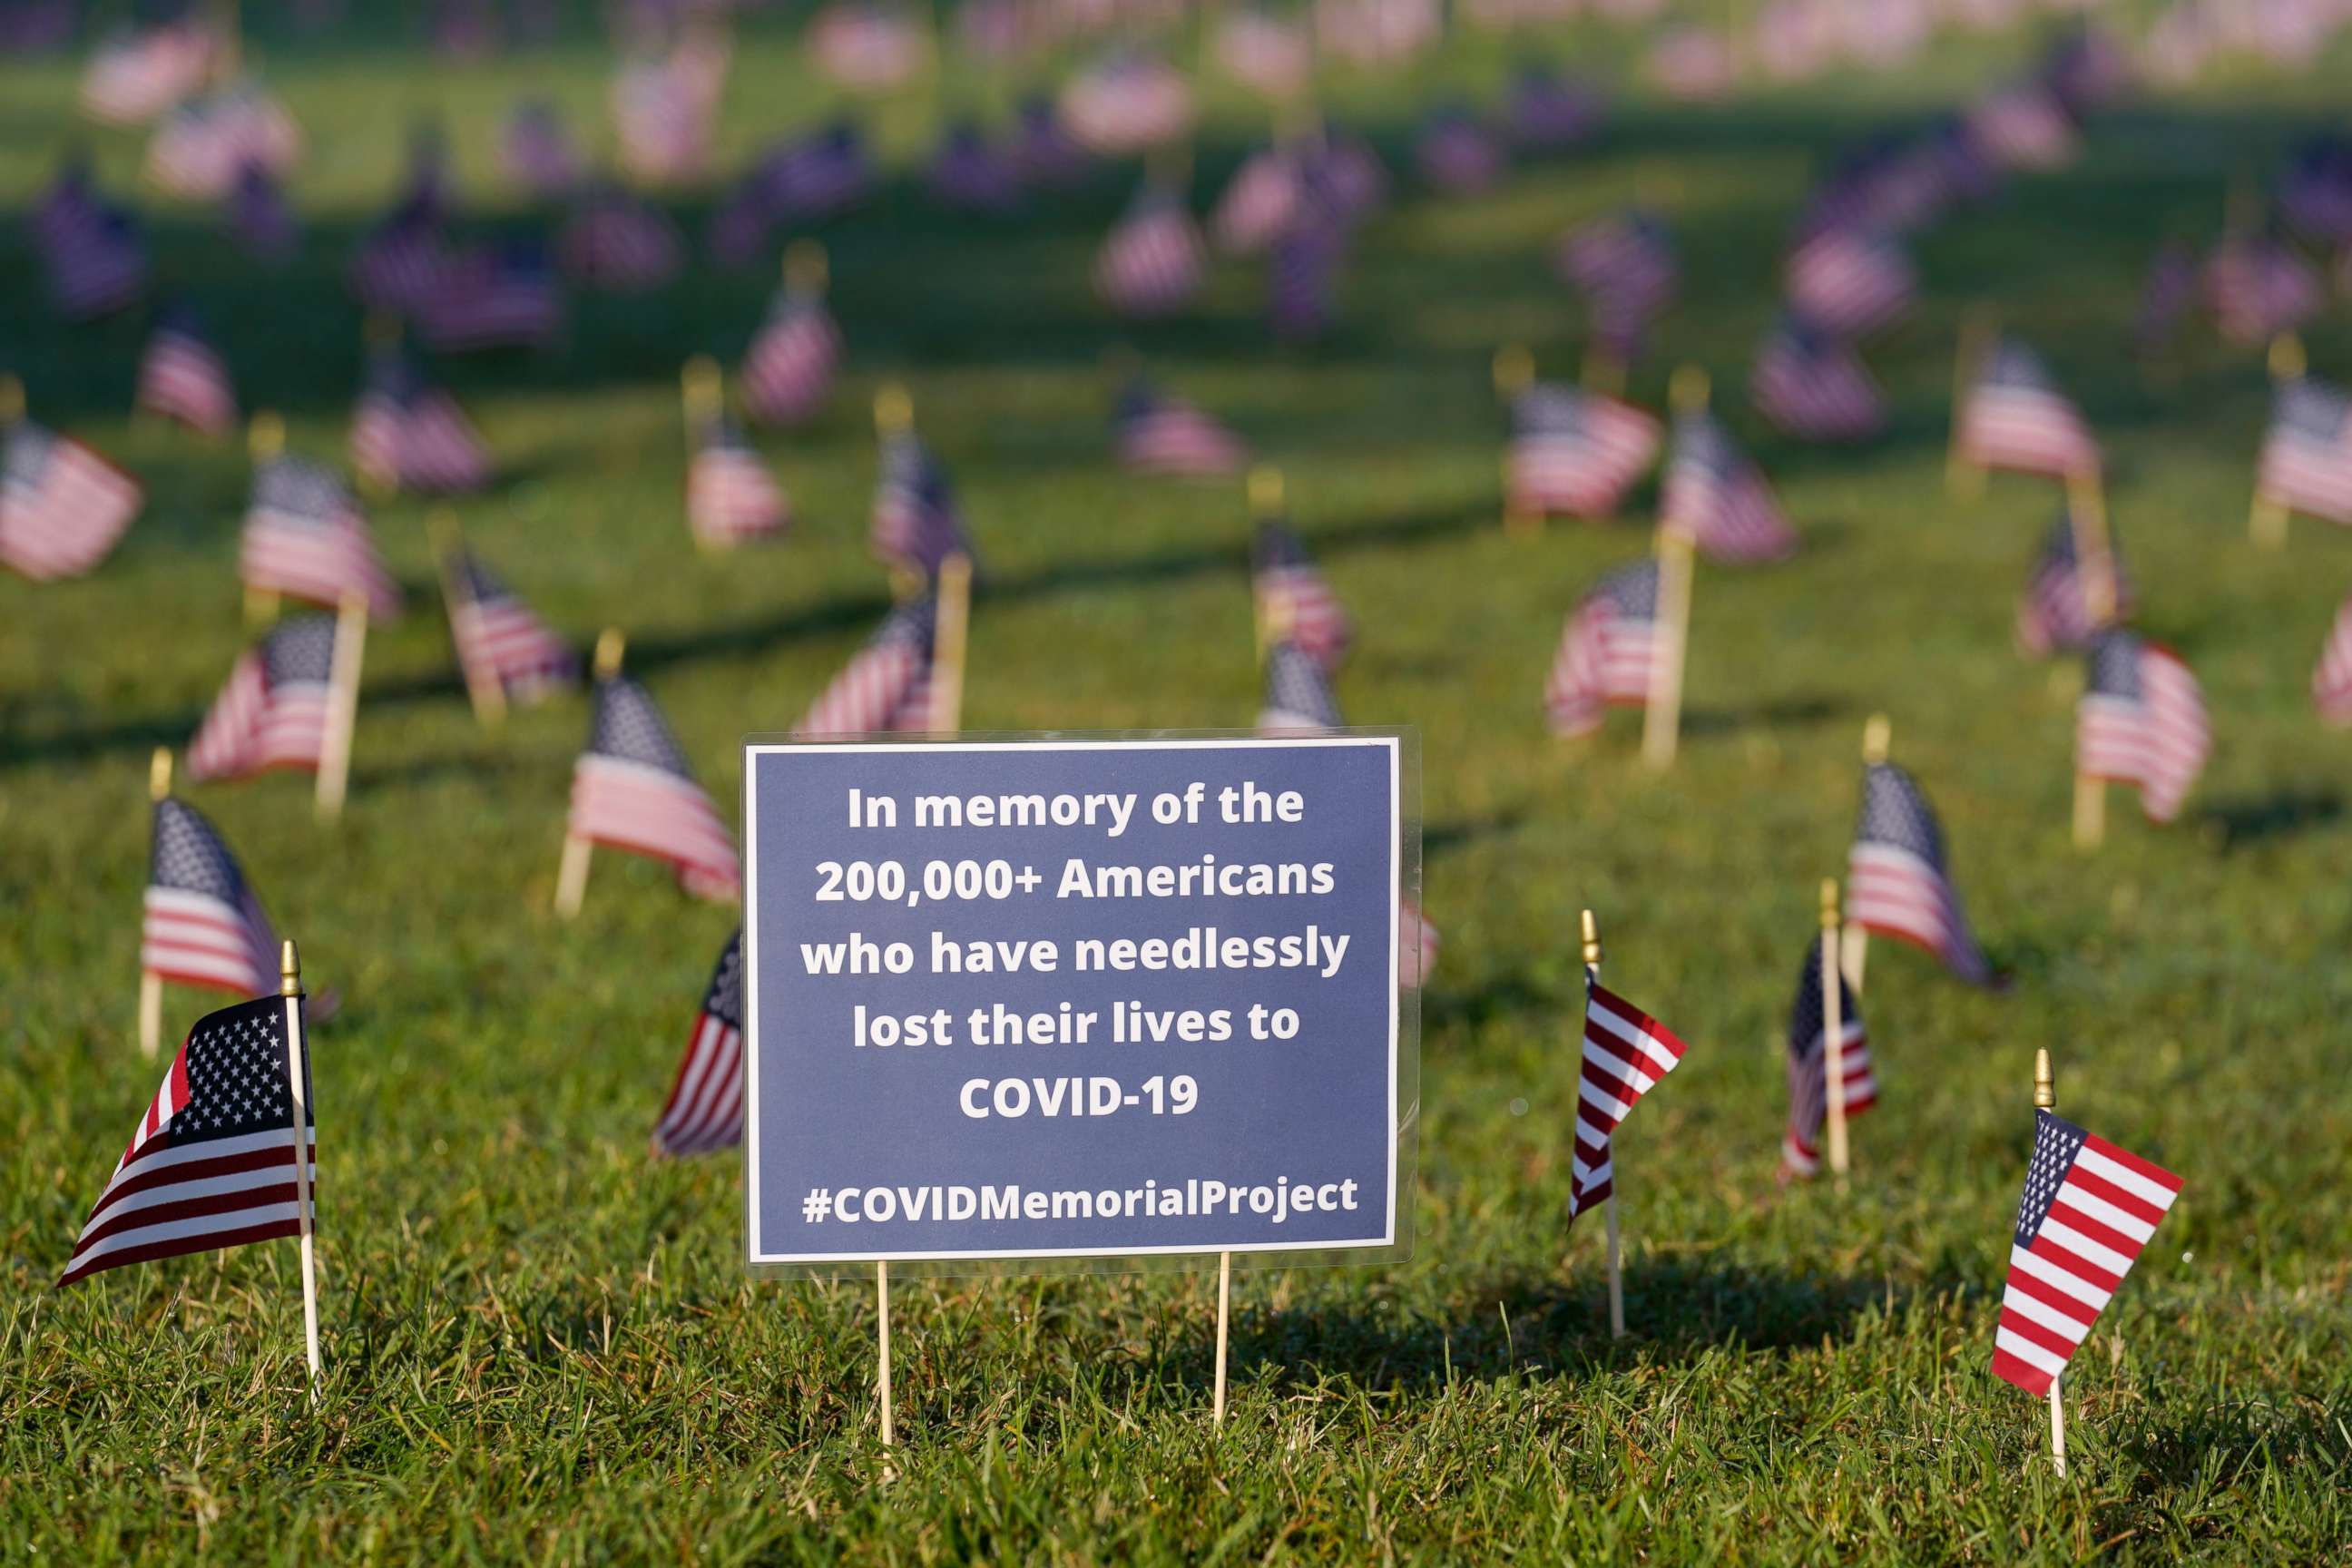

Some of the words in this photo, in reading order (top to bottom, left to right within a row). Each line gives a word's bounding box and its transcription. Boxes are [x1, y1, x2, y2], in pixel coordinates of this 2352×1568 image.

[848, 788, 898, 828] In
[914, 793, 1138, 838] memory
[1152, 781, 1206, 825] of
[1217, 780, 1304, 824] the
[814, 857, 1043, 908] 200,000+
[1055, 853, 1335, 899] Americans
[799, 929, 915, 975] who
[930, 931, 1059, 974] have
[1075, 925, 1351, 978] needlessly
[853, 1004, 953, 1047] lost
[966, 1001, 1098, 1046] their
[1112, 1000, 1233, 1044] lives
[1247, 1003, 1300, 1041] to
[959, 1074, 1199, 1119] COVID-19
[801, 1175, 1358, 1224] #COVIDMemorialProject
